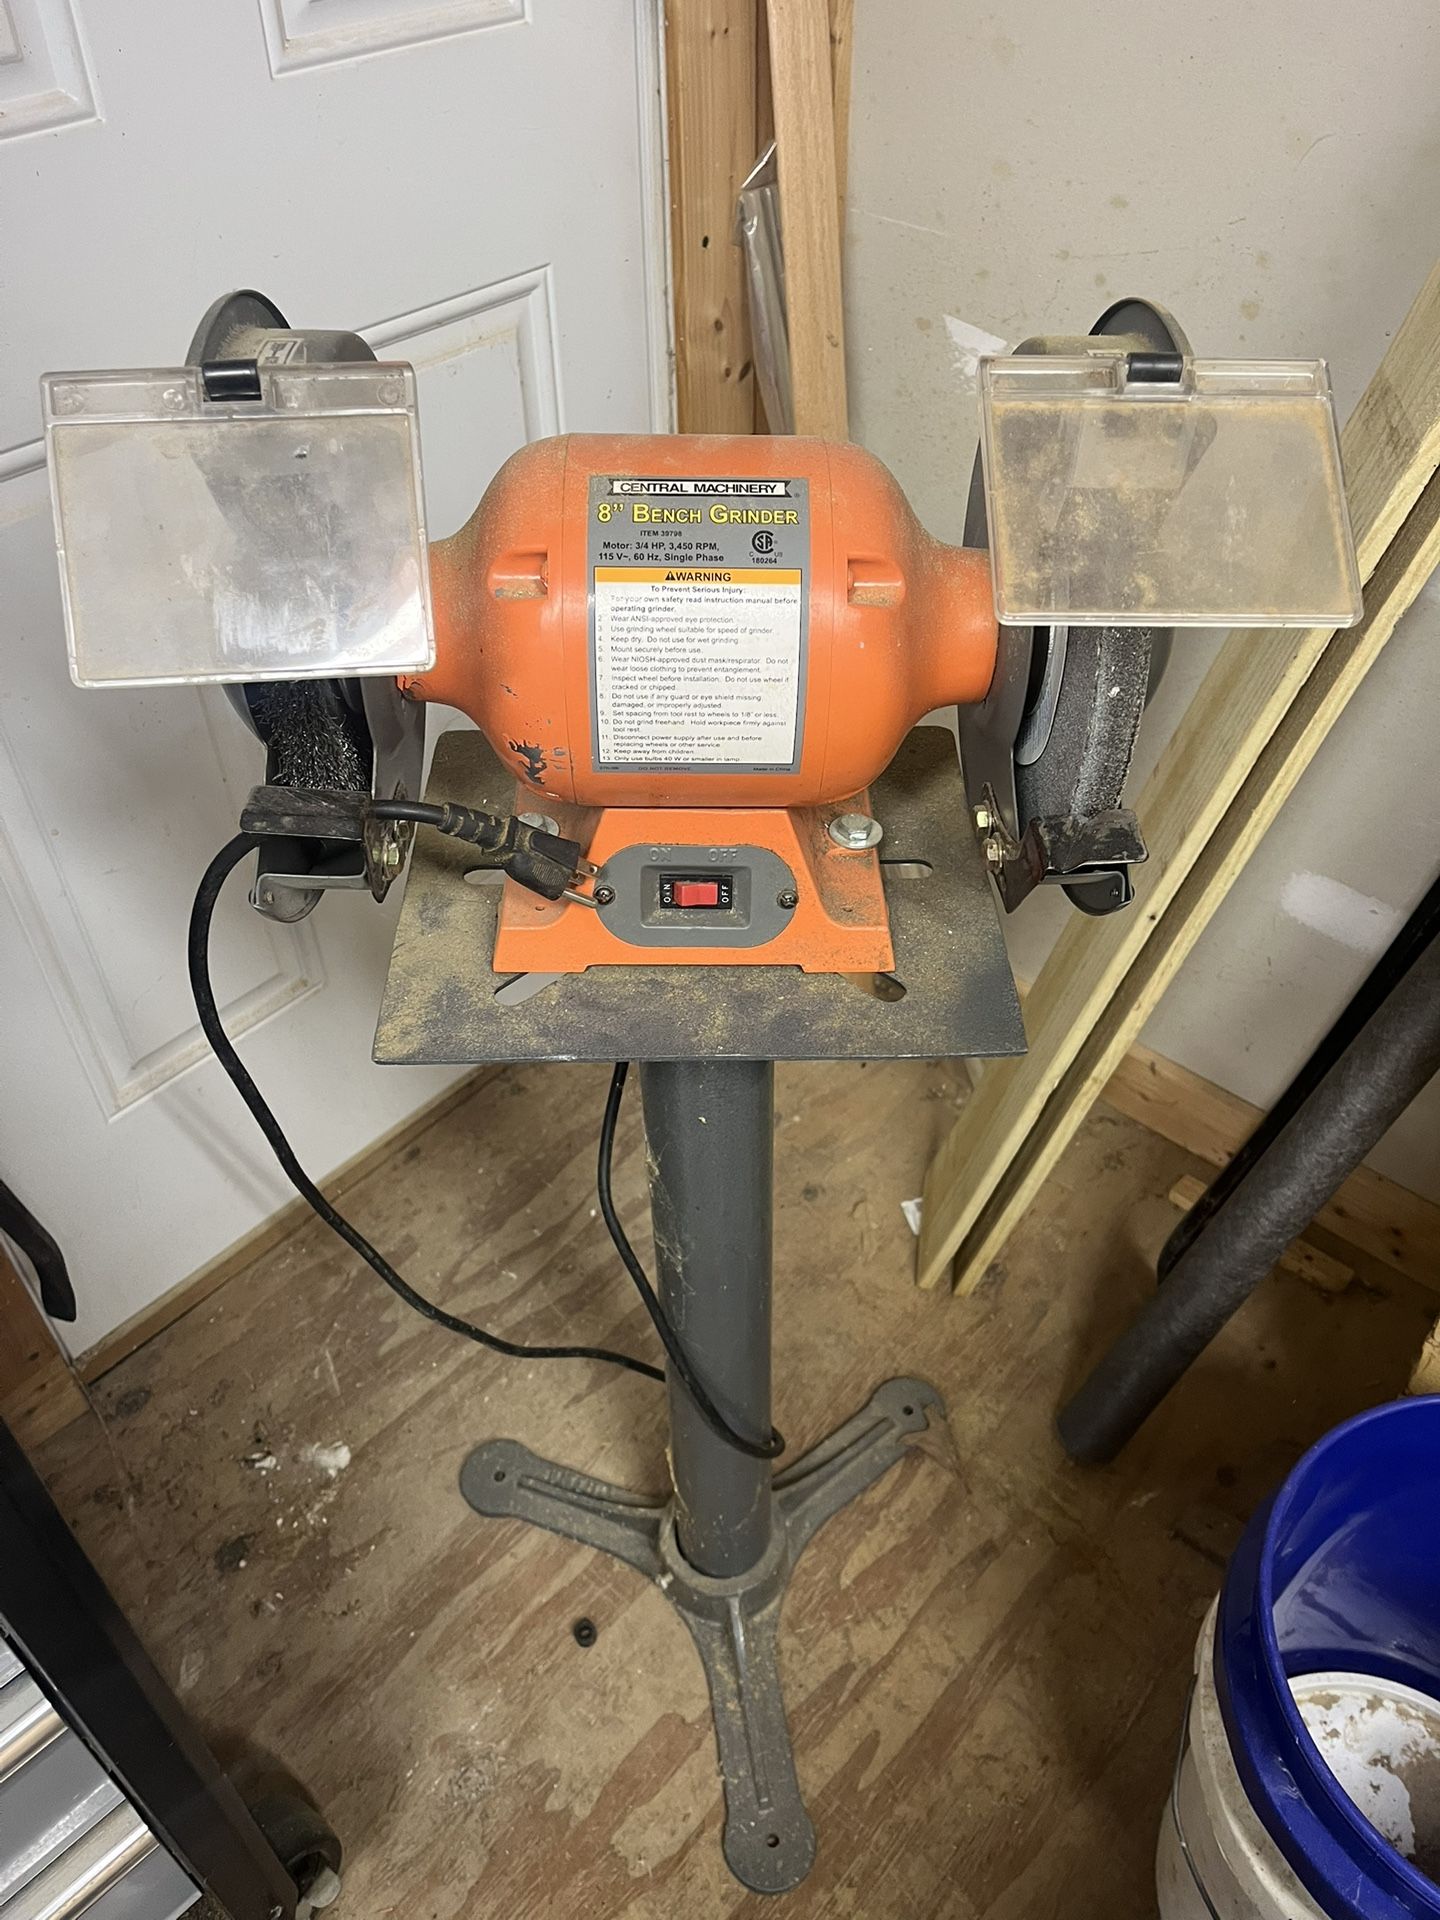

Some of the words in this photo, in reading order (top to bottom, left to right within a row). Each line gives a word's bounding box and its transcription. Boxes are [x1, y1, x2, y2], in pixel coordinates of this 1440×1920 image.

[620, 482, 688, 493] CENTRAL
[693, 483, 777, 494] MACHINERY
[603, 542, 632, 550] Motor:
[635, 542, 649, 550] 3/4
[652, 542, 666, 551] HP,
[669, 542, 693, 551] 3,450
[695, 543, 720, 552] RPM,
[599, 553, 614, 561] 115
[649, 553, 662, 562] Hz,
[664, 554, 693, 563] Single
[695, 554, 724, 562] Phase
[676, 572, 731, 581] WARNING
[662, 596, 683, 604] safety
[626, 626, 654, 634] grinding
[718, 627, 739, 635] speed
[634, 646, 663, 654] securely
[631, 656, 690, 664] NIOSH-approved
[650, 847, 672, 862] ON
[708, 848, 738, 862] OFF
[721, 885, 729, 903] OFF
